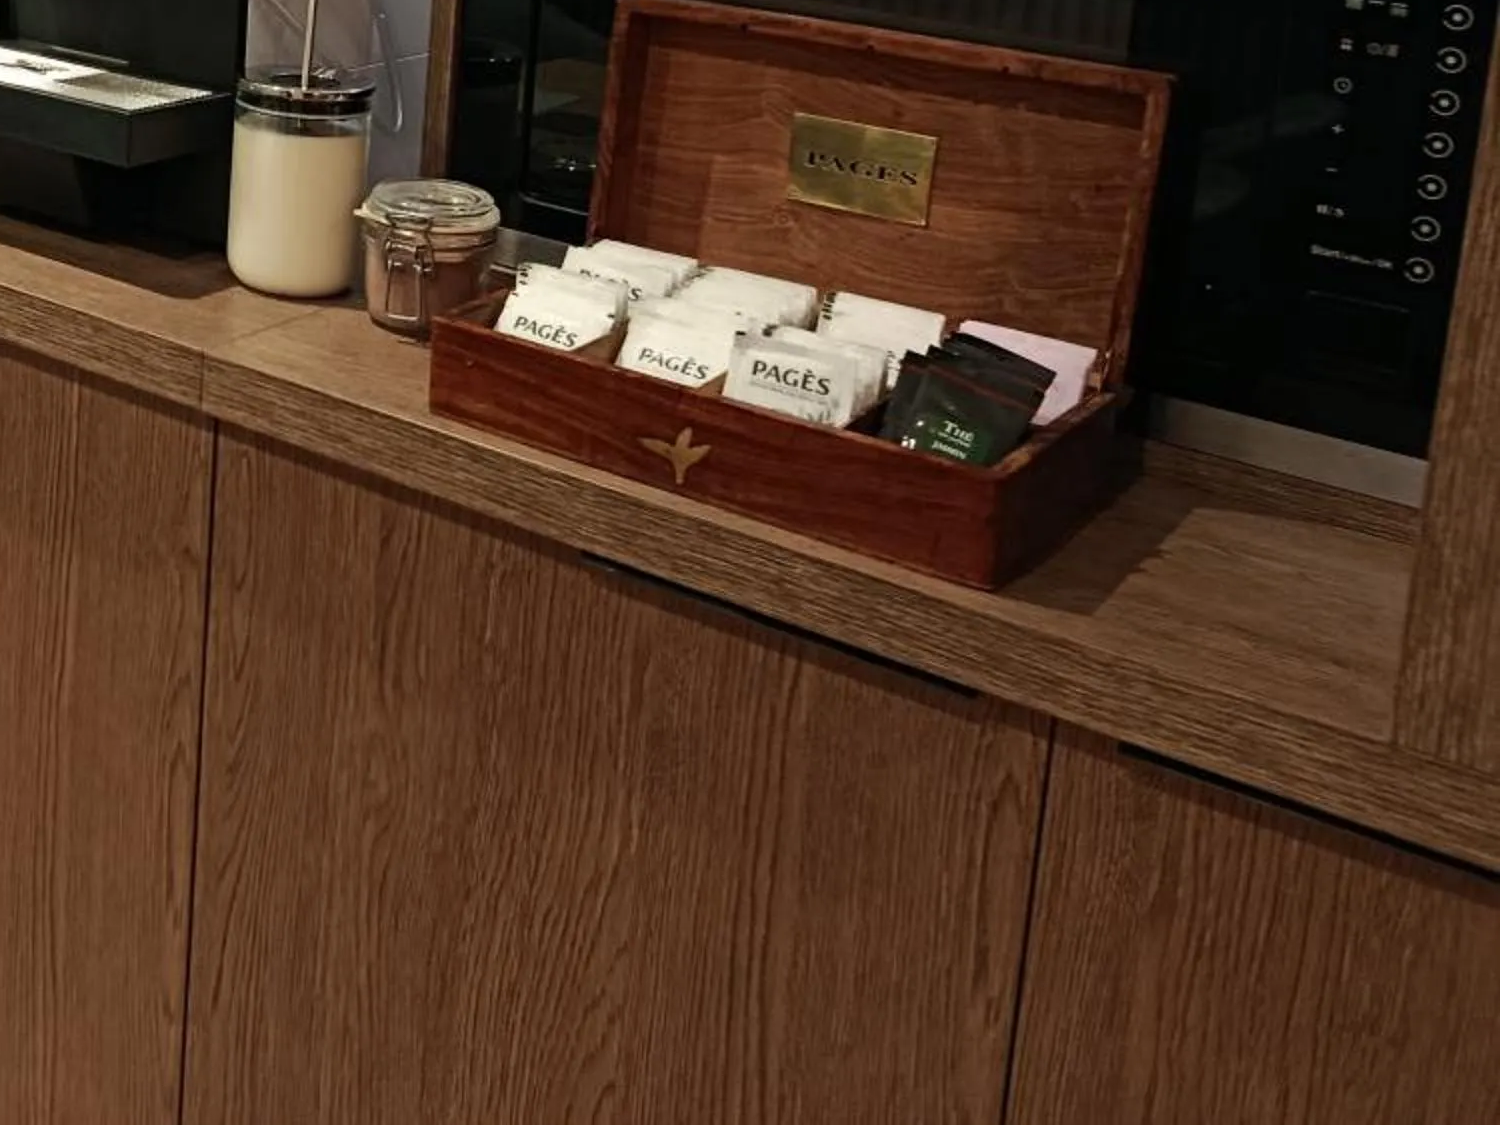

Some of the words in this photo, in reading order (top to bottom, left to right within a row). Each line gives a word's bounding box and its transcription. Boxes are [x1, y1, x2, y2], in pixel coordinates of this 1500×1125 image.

[513, 315, 579, 349] PAGÈS
[637, 347, 710, 381] PAGÈS
[752, 359, 832, 397] PAGÈS
